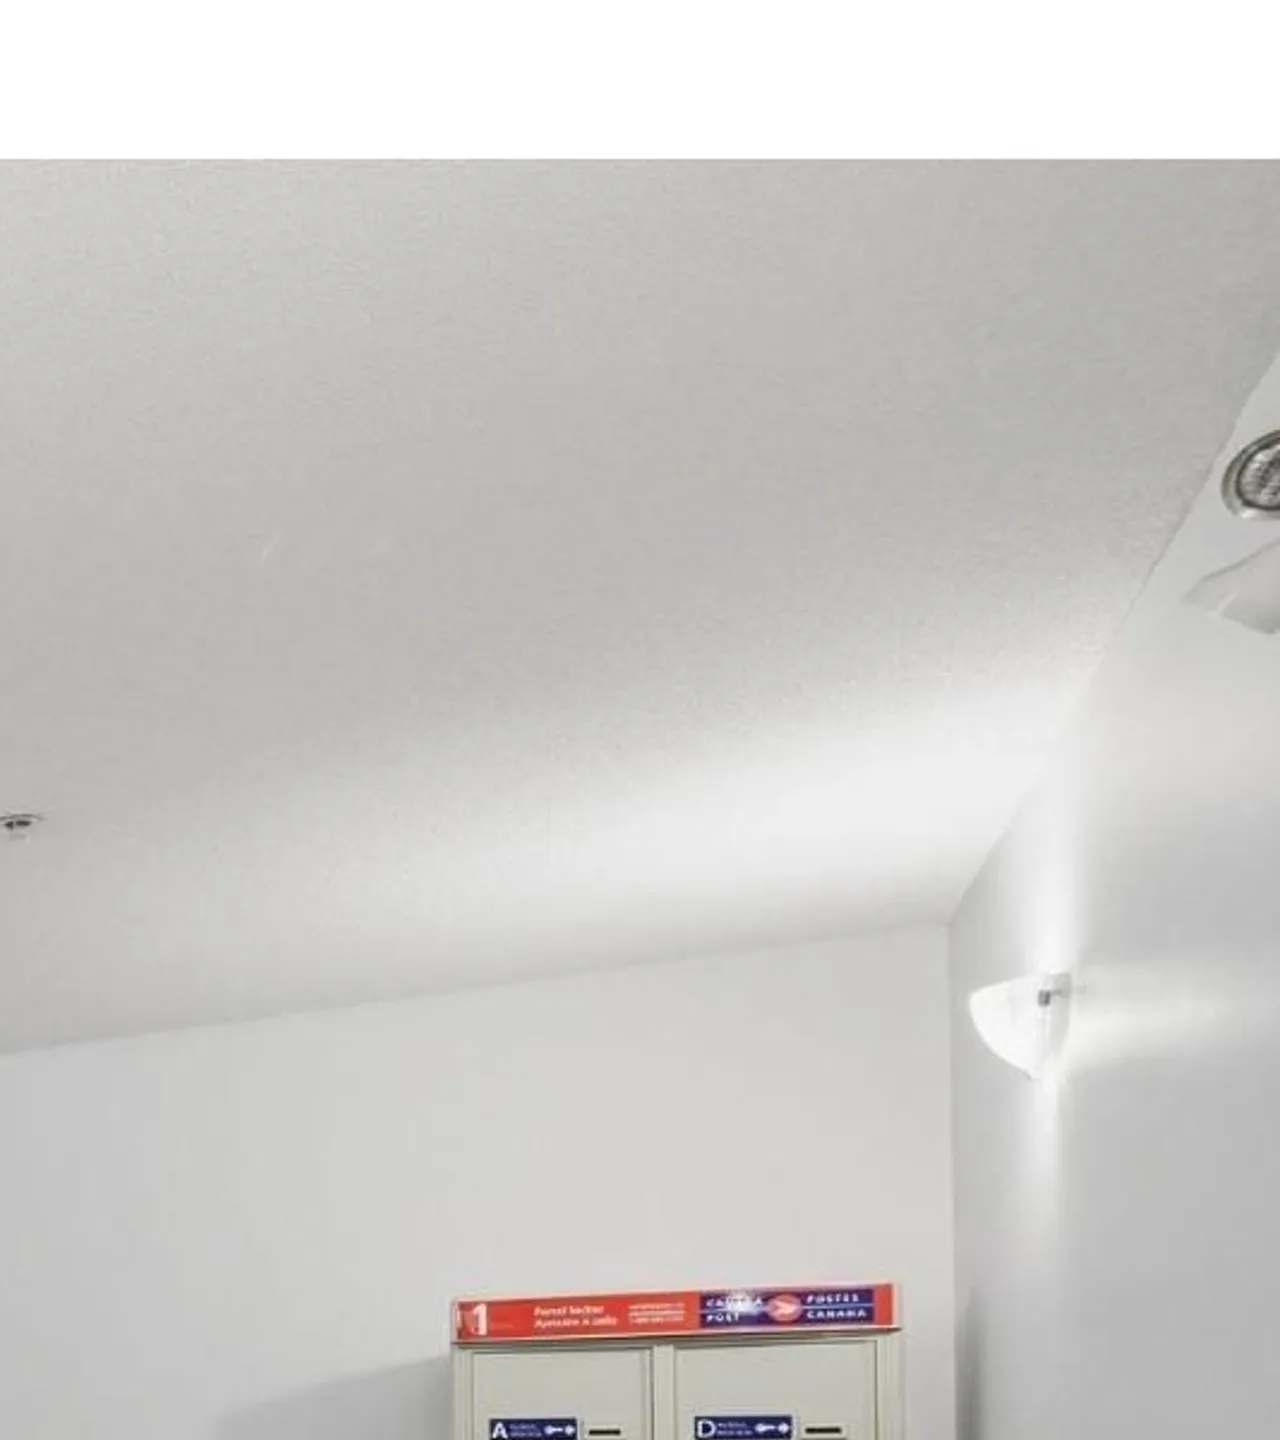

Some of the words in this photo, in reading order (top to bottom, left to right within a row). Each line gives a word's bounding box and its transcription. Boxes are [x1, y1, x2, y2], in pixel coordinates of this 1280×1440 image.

[472, 1303, 487, 1335] 1
[492, 1421, 508, 1439] A
[697, 1419, 716, 1438] D
